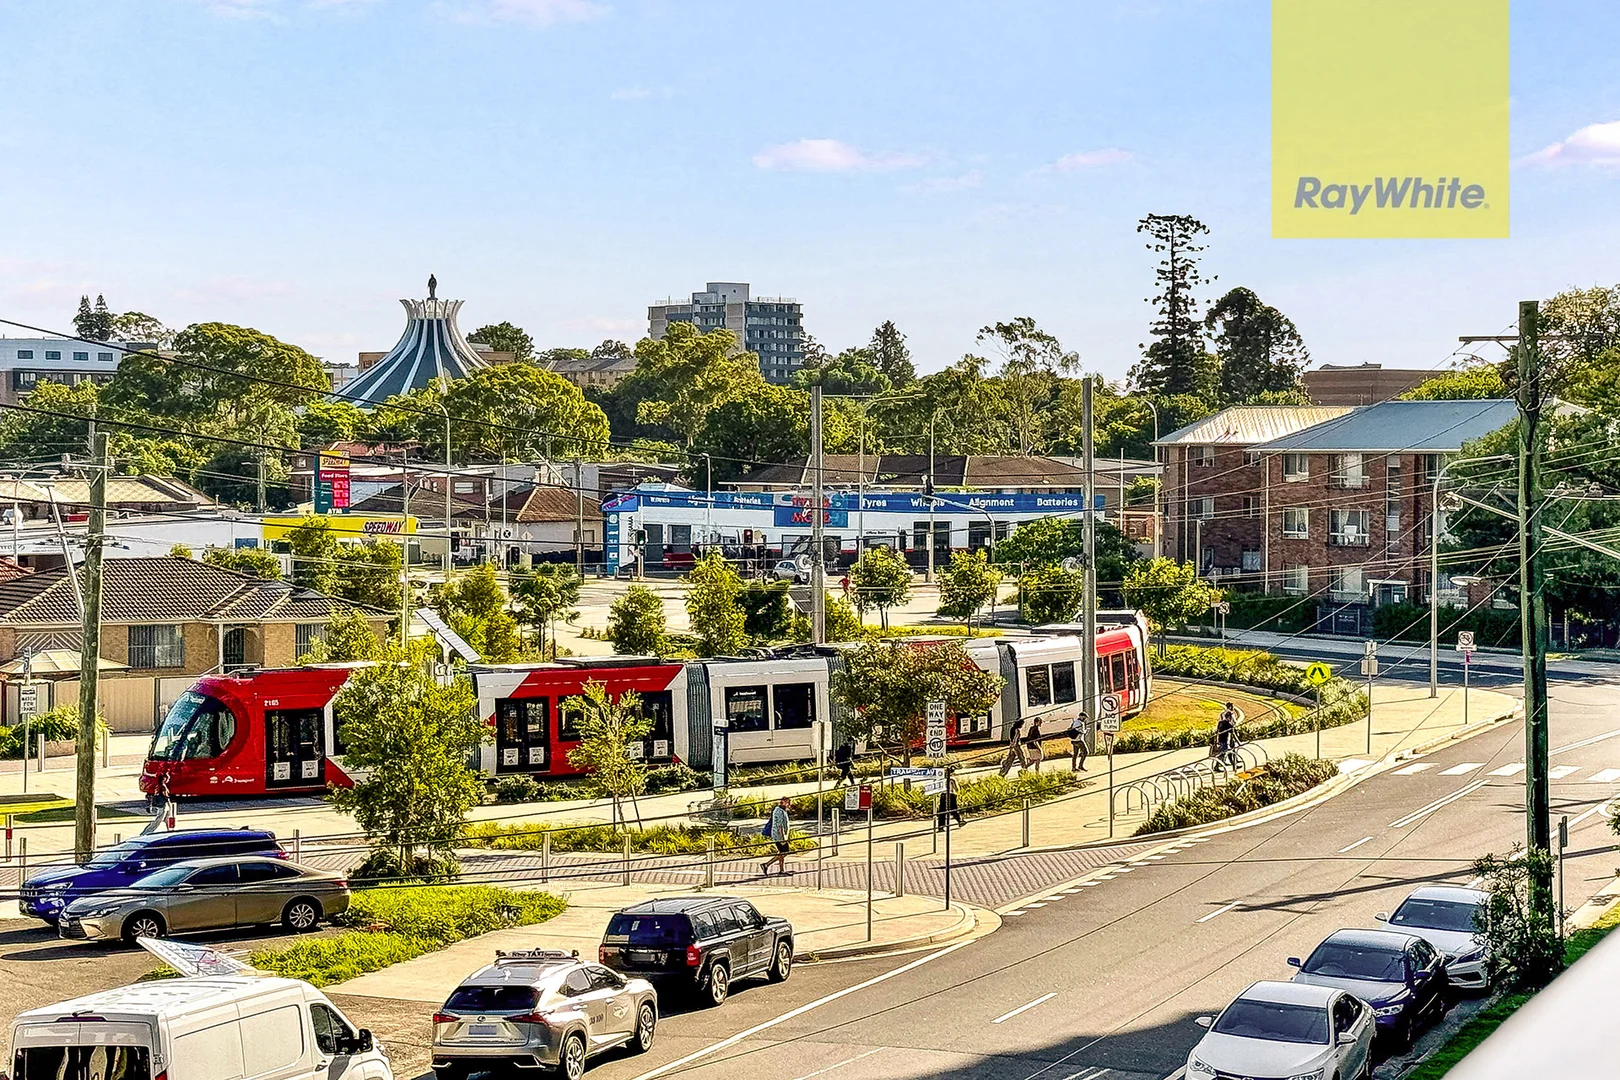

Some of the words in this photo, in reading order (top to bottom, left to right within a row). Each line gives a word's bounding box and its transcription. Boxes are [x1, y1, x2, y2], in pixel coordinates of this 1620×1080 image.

[687, 495, 716, 506] Alignmet
[862, 498, 887, 508] Tyres
[911, 497, 945, 507] Whels
[968, 498, 1015, 509] Alignment
[1037, 497, 1078, 507] Batteries
[791, 512, 831, 523] MOE
[364, 521, 404, 533] SPEEDWAY
